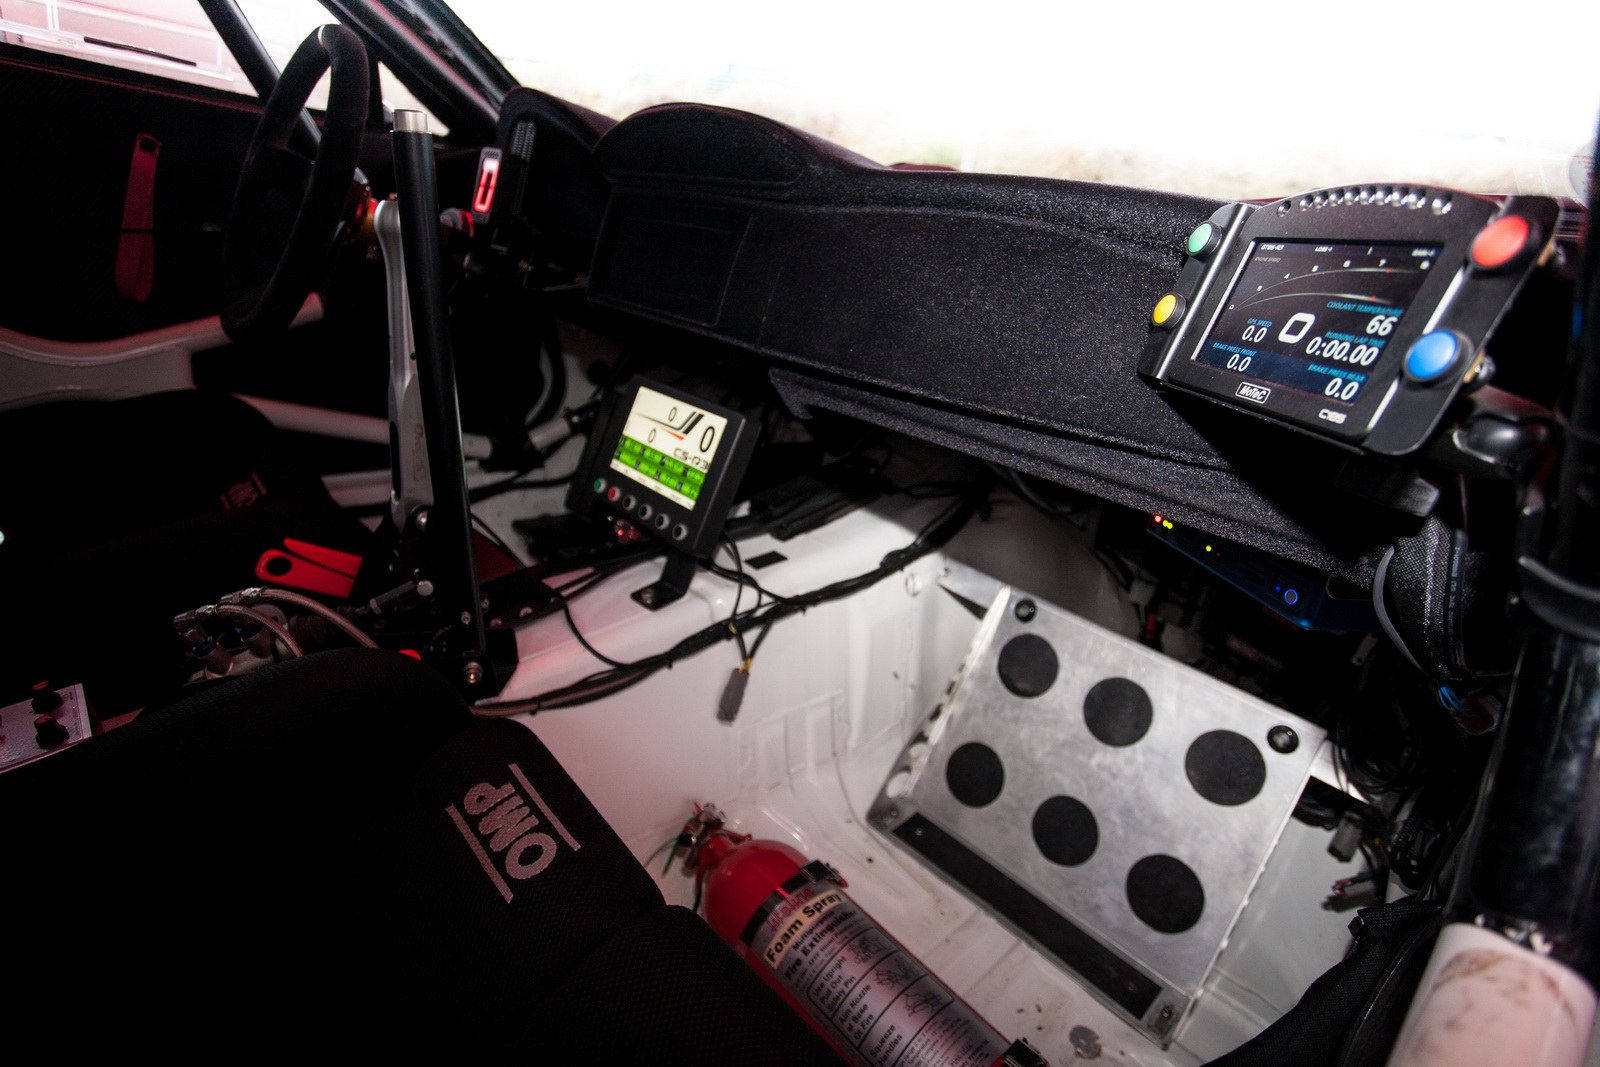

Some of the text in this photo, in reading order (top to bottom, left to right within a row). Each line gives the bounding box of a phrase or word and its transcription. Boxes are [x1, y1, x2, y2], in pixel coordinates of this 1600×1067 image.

[1326, 301, 1404, 317] COOLANT TEMPERATURE
[1242, 325, 1268, 343] 0.0
[1257, 320, 1273, 328] SPEED
[1278, 312, 1316, 344] 0
[1366, 314, 1398, 336] 66
[1212, 342, 1229, 350] BRAKE
[1227, 345, 1242, 354] PRESS
[1325, 331, 1387, 348] RUNNING LAP TIME
[1305, 336, 1380, 366] 0:00.00
[1226, 354, 1252, 372] 0.0
[1307, 363, 1367, 383] BRAKE PRESS REAR
[1239, 385, 1267, 400] MoTeC
[1324, 378, 1360, 401] 0.0
[668, 406, 678, 422] 0
[647, 428, 657, 443] 0
[700, 425, 715, 453] 0
[463, 782, 558, 880] OMP
[766, 893, 842, 963] Foam Spray
[785, 958, 803, 980] Fire
[813, 956, 846, 998] Use Upright
[820, 976, 843, 1006] Pull Out
[827, 976, 856, 1012] Safety Pin
[840, 985, 871, 1025] Aim Nozzle
[852, 1004, 869, 1024] Base
[861, 1014, 875, 1031] Fire
[870, 1025, 896, 1059] Squeeze
[879, 1034, 903, 1066] Handles
